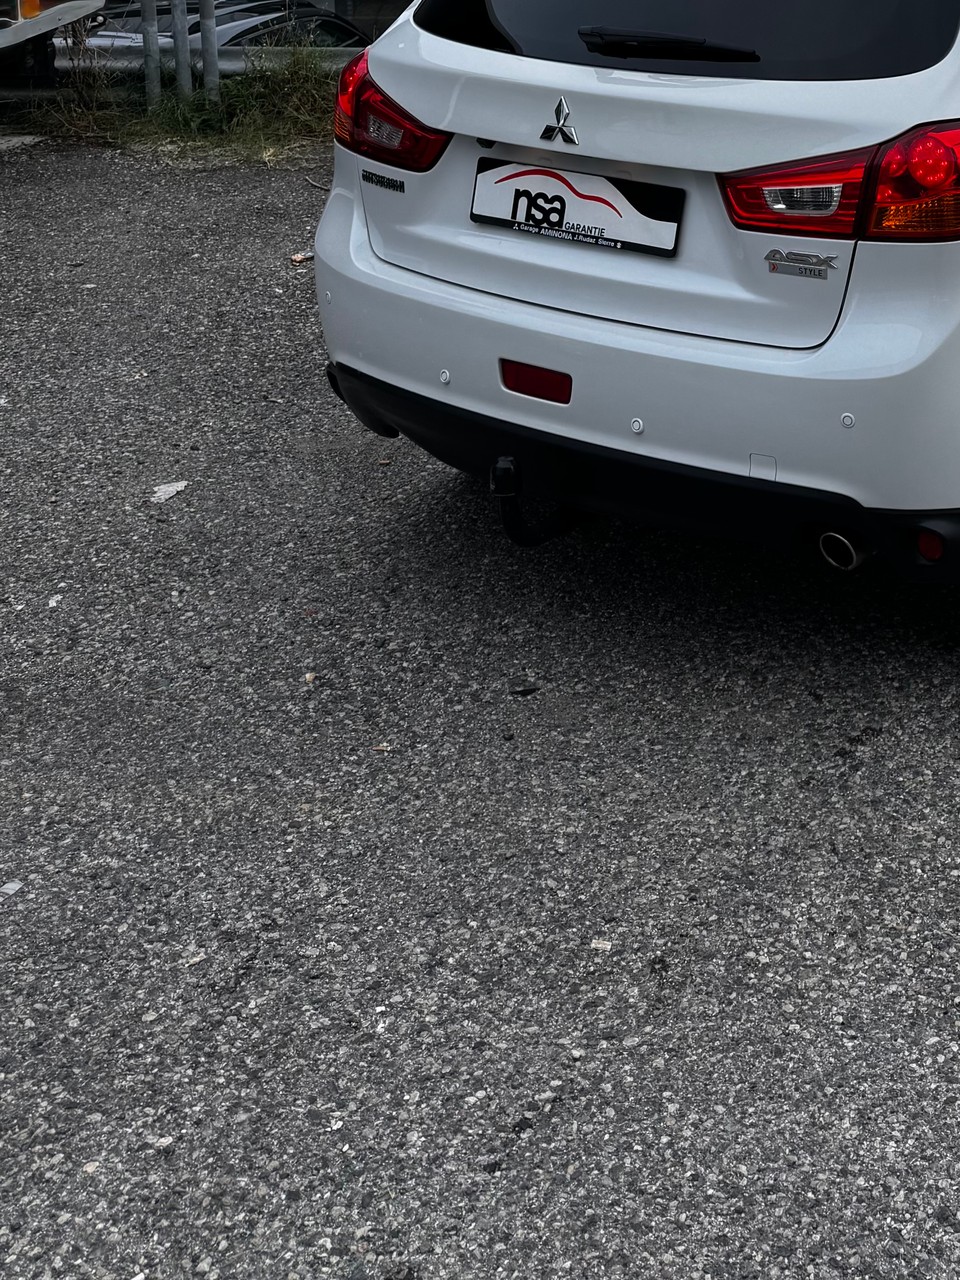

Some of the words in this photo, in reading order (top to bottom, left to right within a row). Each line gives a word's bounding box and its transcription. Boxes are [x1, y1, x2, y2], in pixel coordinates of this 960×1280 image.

[510, 187, 567, 229] nsa
[520, 222, 539, 234] Garage
[540, 227, 573, 241] AMINONA
[597, 238, 615, 247] Sierre
[564, 221, 606, 237] GARANTIE
[764, 247, 838, 270] ASX
[798, 267, 823, 277] STYLE
